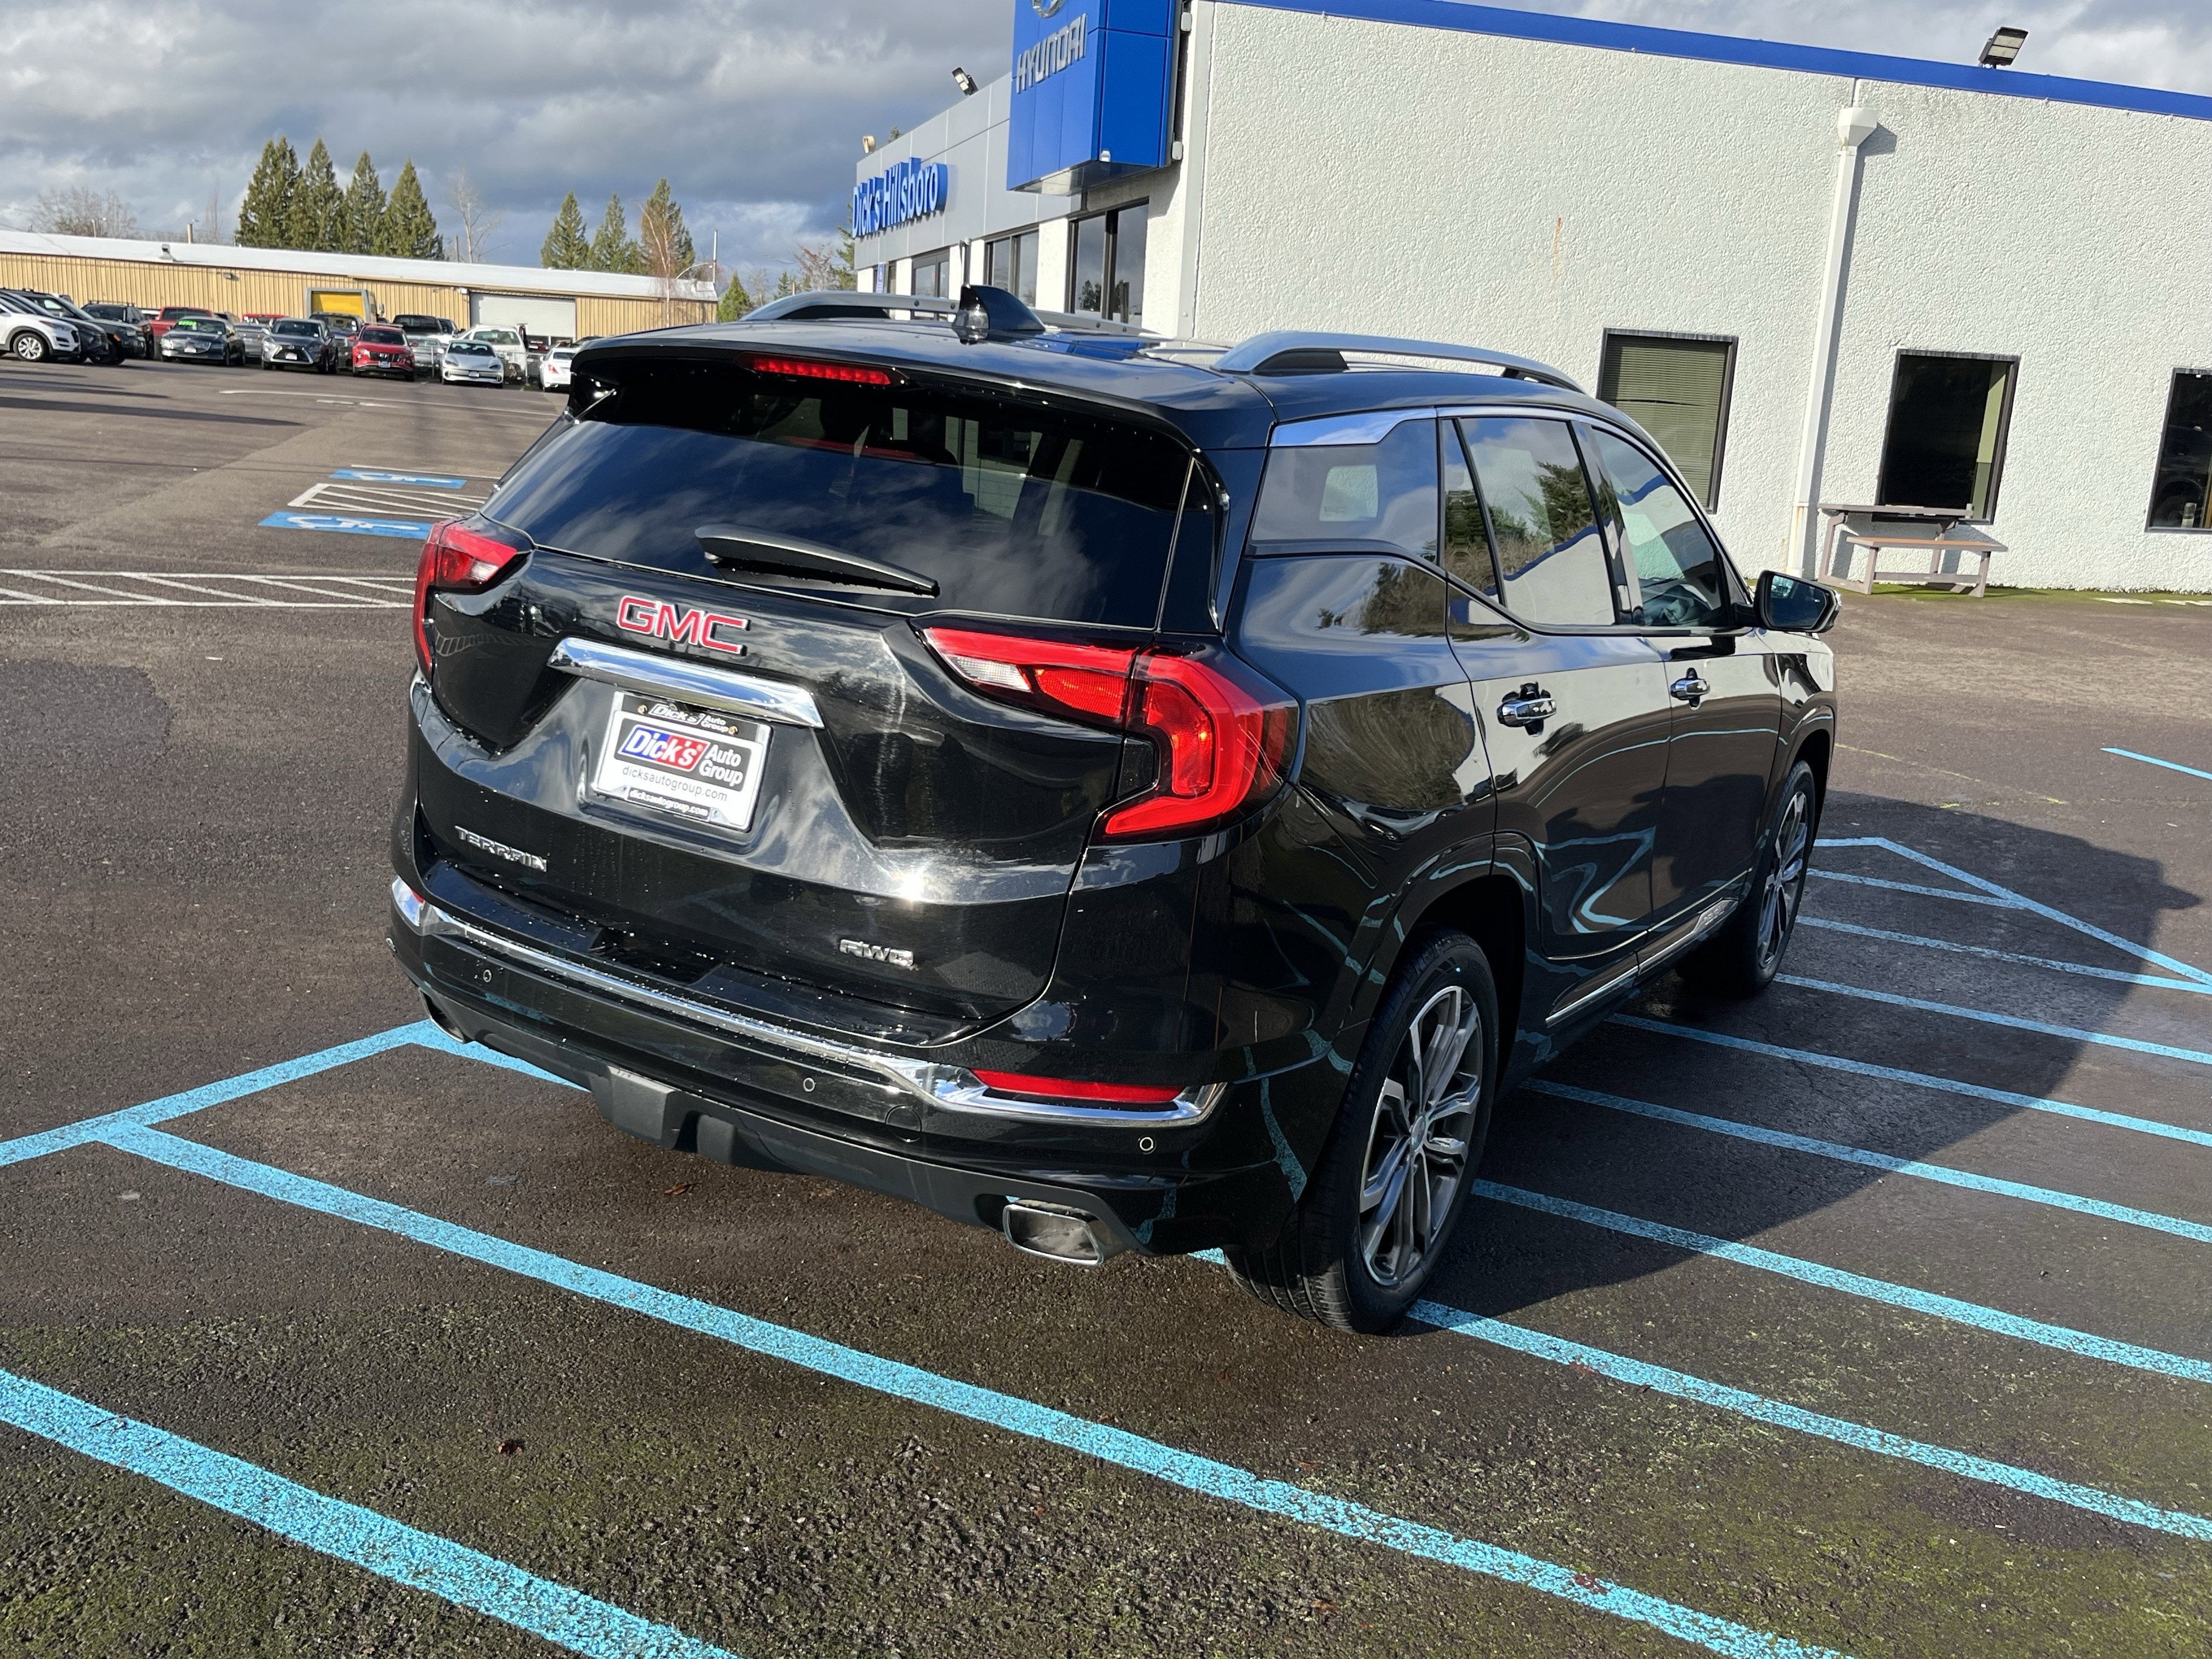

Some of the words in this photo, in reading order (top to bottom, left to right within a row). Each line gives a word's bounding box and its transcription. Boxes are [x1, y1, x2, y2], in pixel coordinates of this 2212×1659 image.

[1017, 13, 1086, 94] HYUNDAI
[853, 177, 881, 238] Dick's
[883, 157, 940, 228] Hillsboro
[617, 595, 748, 654] GMC
[701, 720, 729, 732] Group
[704, 715, 726, 725] Auto
[625, 729, 697, 766] Dick's
[705, 744, 741, 767] Auto
[623, 766, 728, 802] dicksautogroup.com
[699, 759, 744, 786] Group
[630, 789, 708, 816] dicksautogroup.com
[455, 825, 547, 872] TERRAIN
